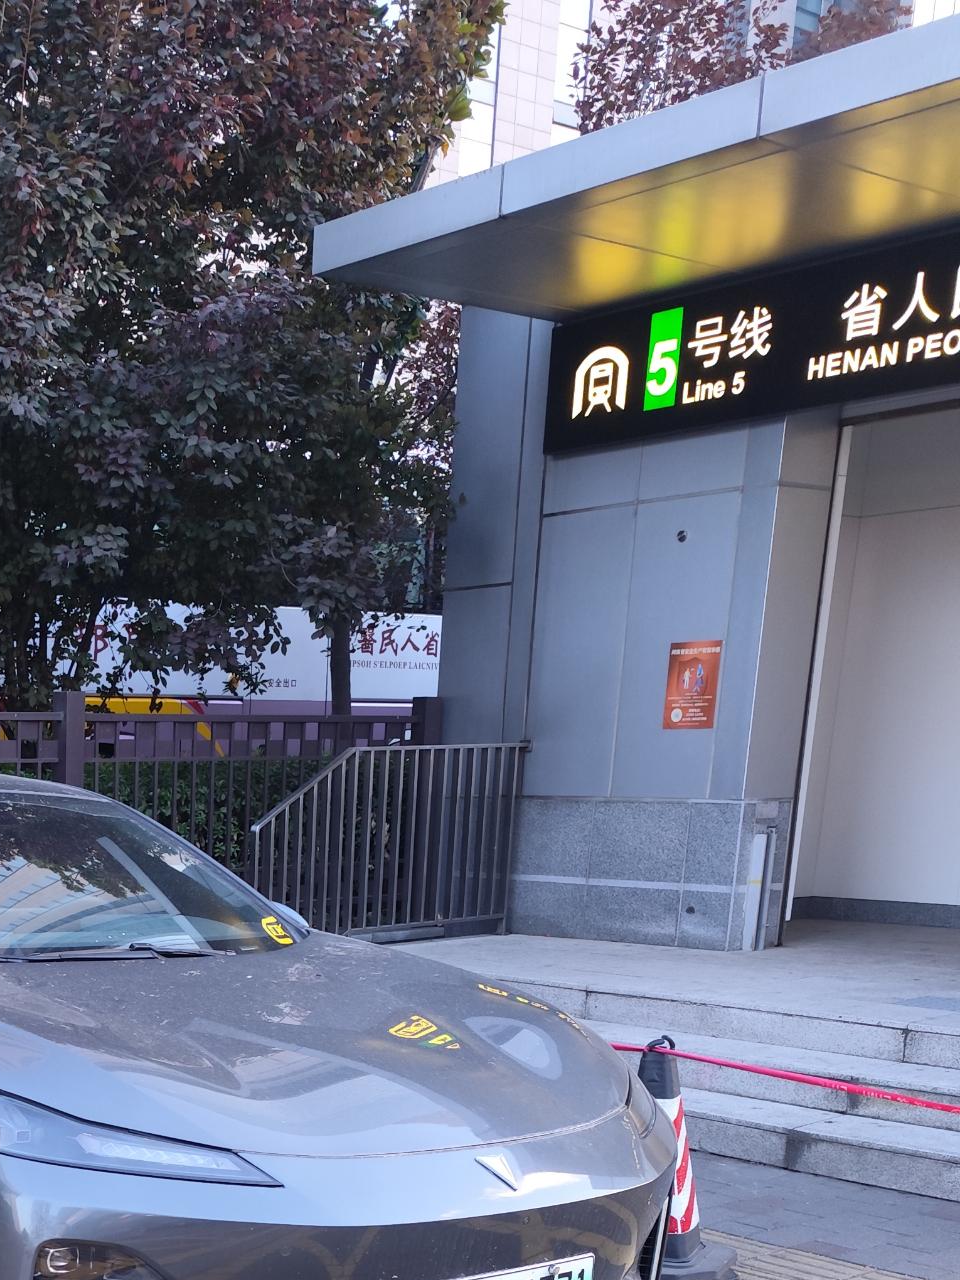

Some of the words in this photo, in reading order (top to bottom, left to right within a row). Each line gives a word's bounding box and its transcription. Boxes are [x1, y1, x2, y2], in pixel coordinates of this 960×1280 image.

[841, 265, 960, 341] 省人
[806, 341, 900, 381] HENAN
[906, 329, 960, 363] PEO
[681, 378, 725, 405] Line
[731, 371, 746, 395] 5
